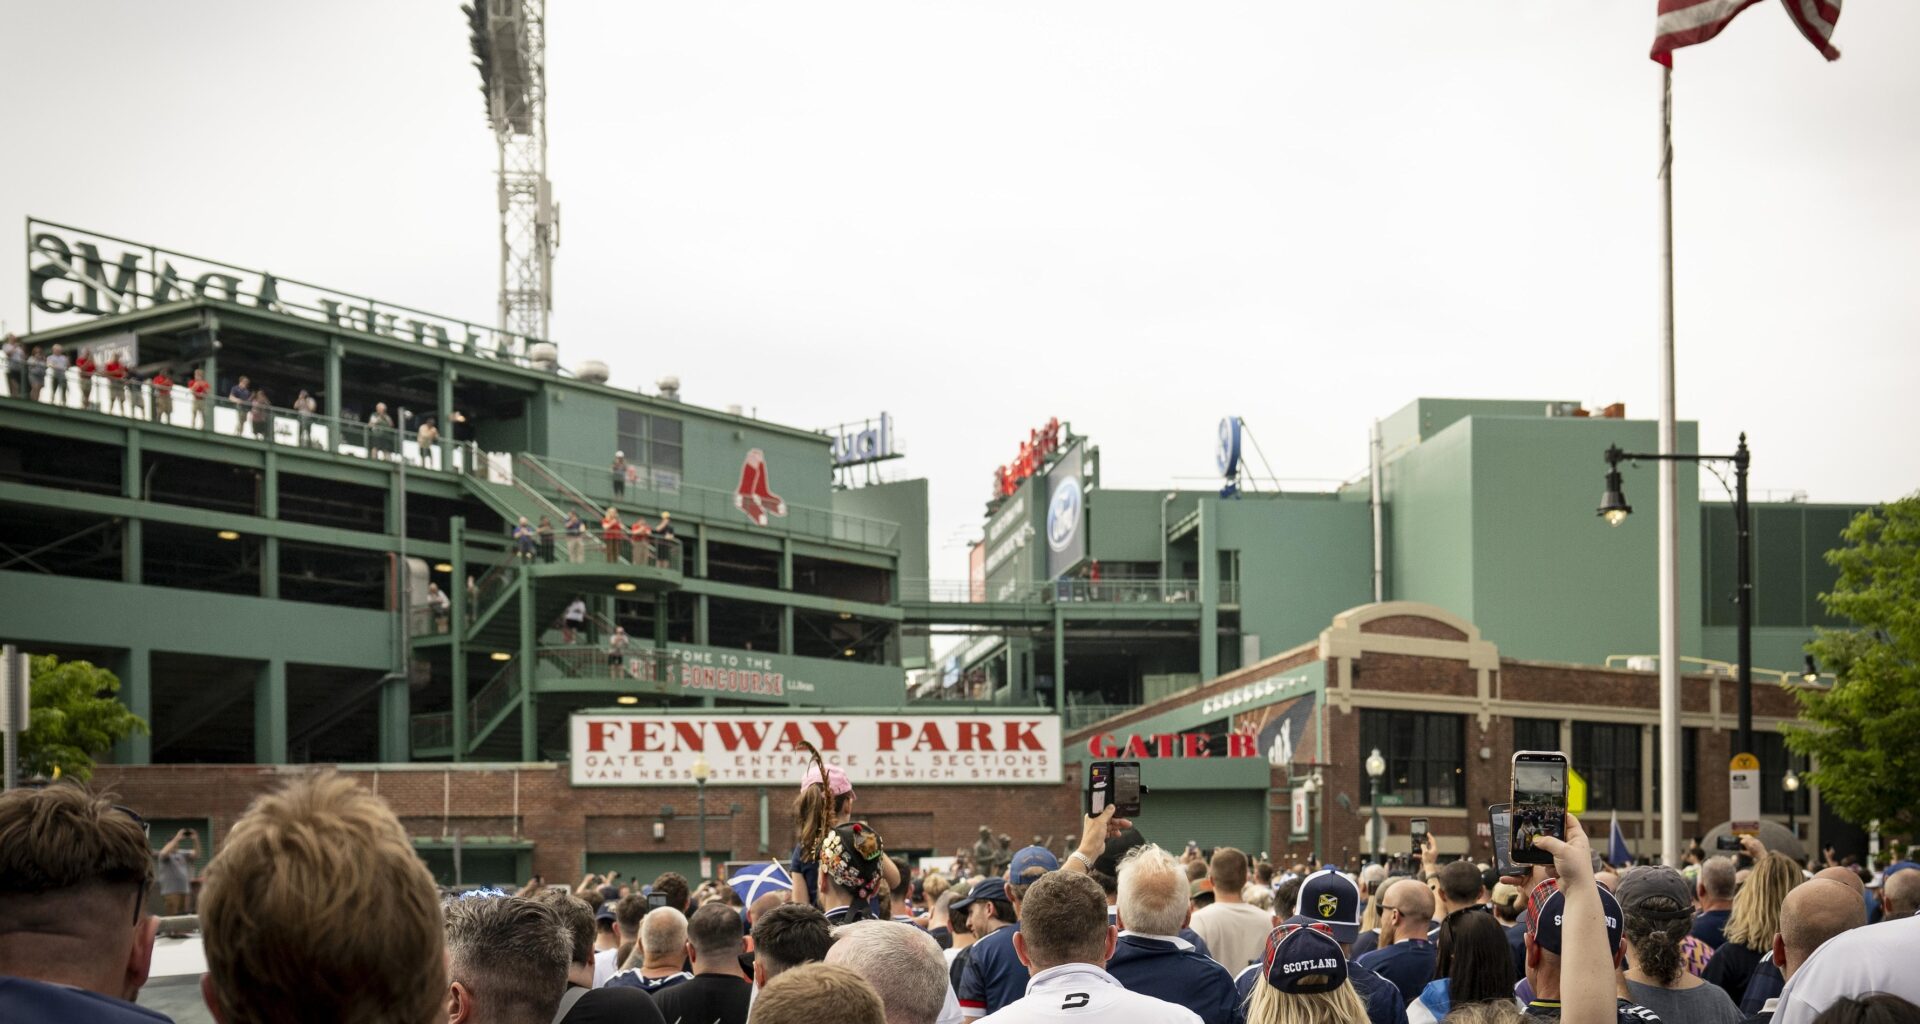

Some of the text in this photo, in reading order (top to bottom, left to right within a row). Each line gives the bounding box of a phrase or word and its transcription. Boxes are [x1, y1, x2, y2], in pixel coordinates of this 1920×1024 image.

[833, 411, 887, 462] ual
[720, 653, 738, 667] TO
[746, 657, 772, 670] THE
[680, 663, 784, 697] CONCOURSE
[586, 721, 1047, 752] FENWAY PARK
[1087, 733, 1262, 759] GATE B
[586, 755, 1049, 767] GATE B ENTRACE ALL SECTIONS
[586, 768, 1049, 779] VAN NESS STREET IPSWICH STREET
[1283, 958, 1338, 975] SCOTLAND
